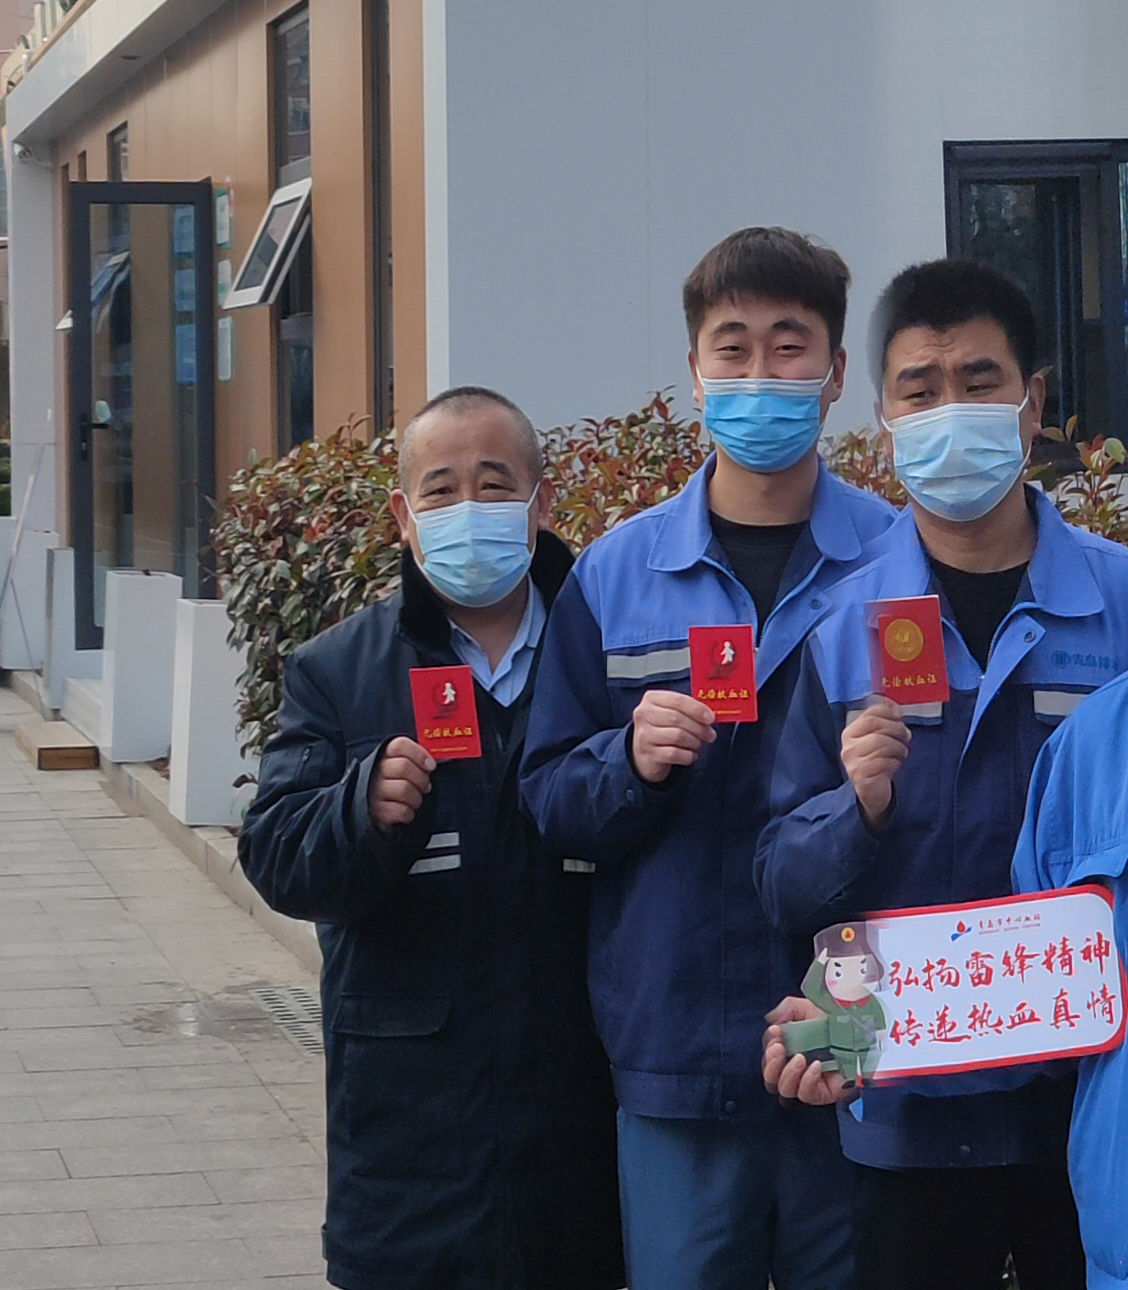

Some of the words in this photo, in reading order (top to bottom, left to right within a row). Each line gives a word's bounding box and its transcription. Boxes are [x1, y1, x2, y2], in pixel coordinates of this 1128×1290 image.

[888, 931, 1112, 998] 弘扬雷锋精神
[889, 983, 1117, 1047] 传递热血真情
